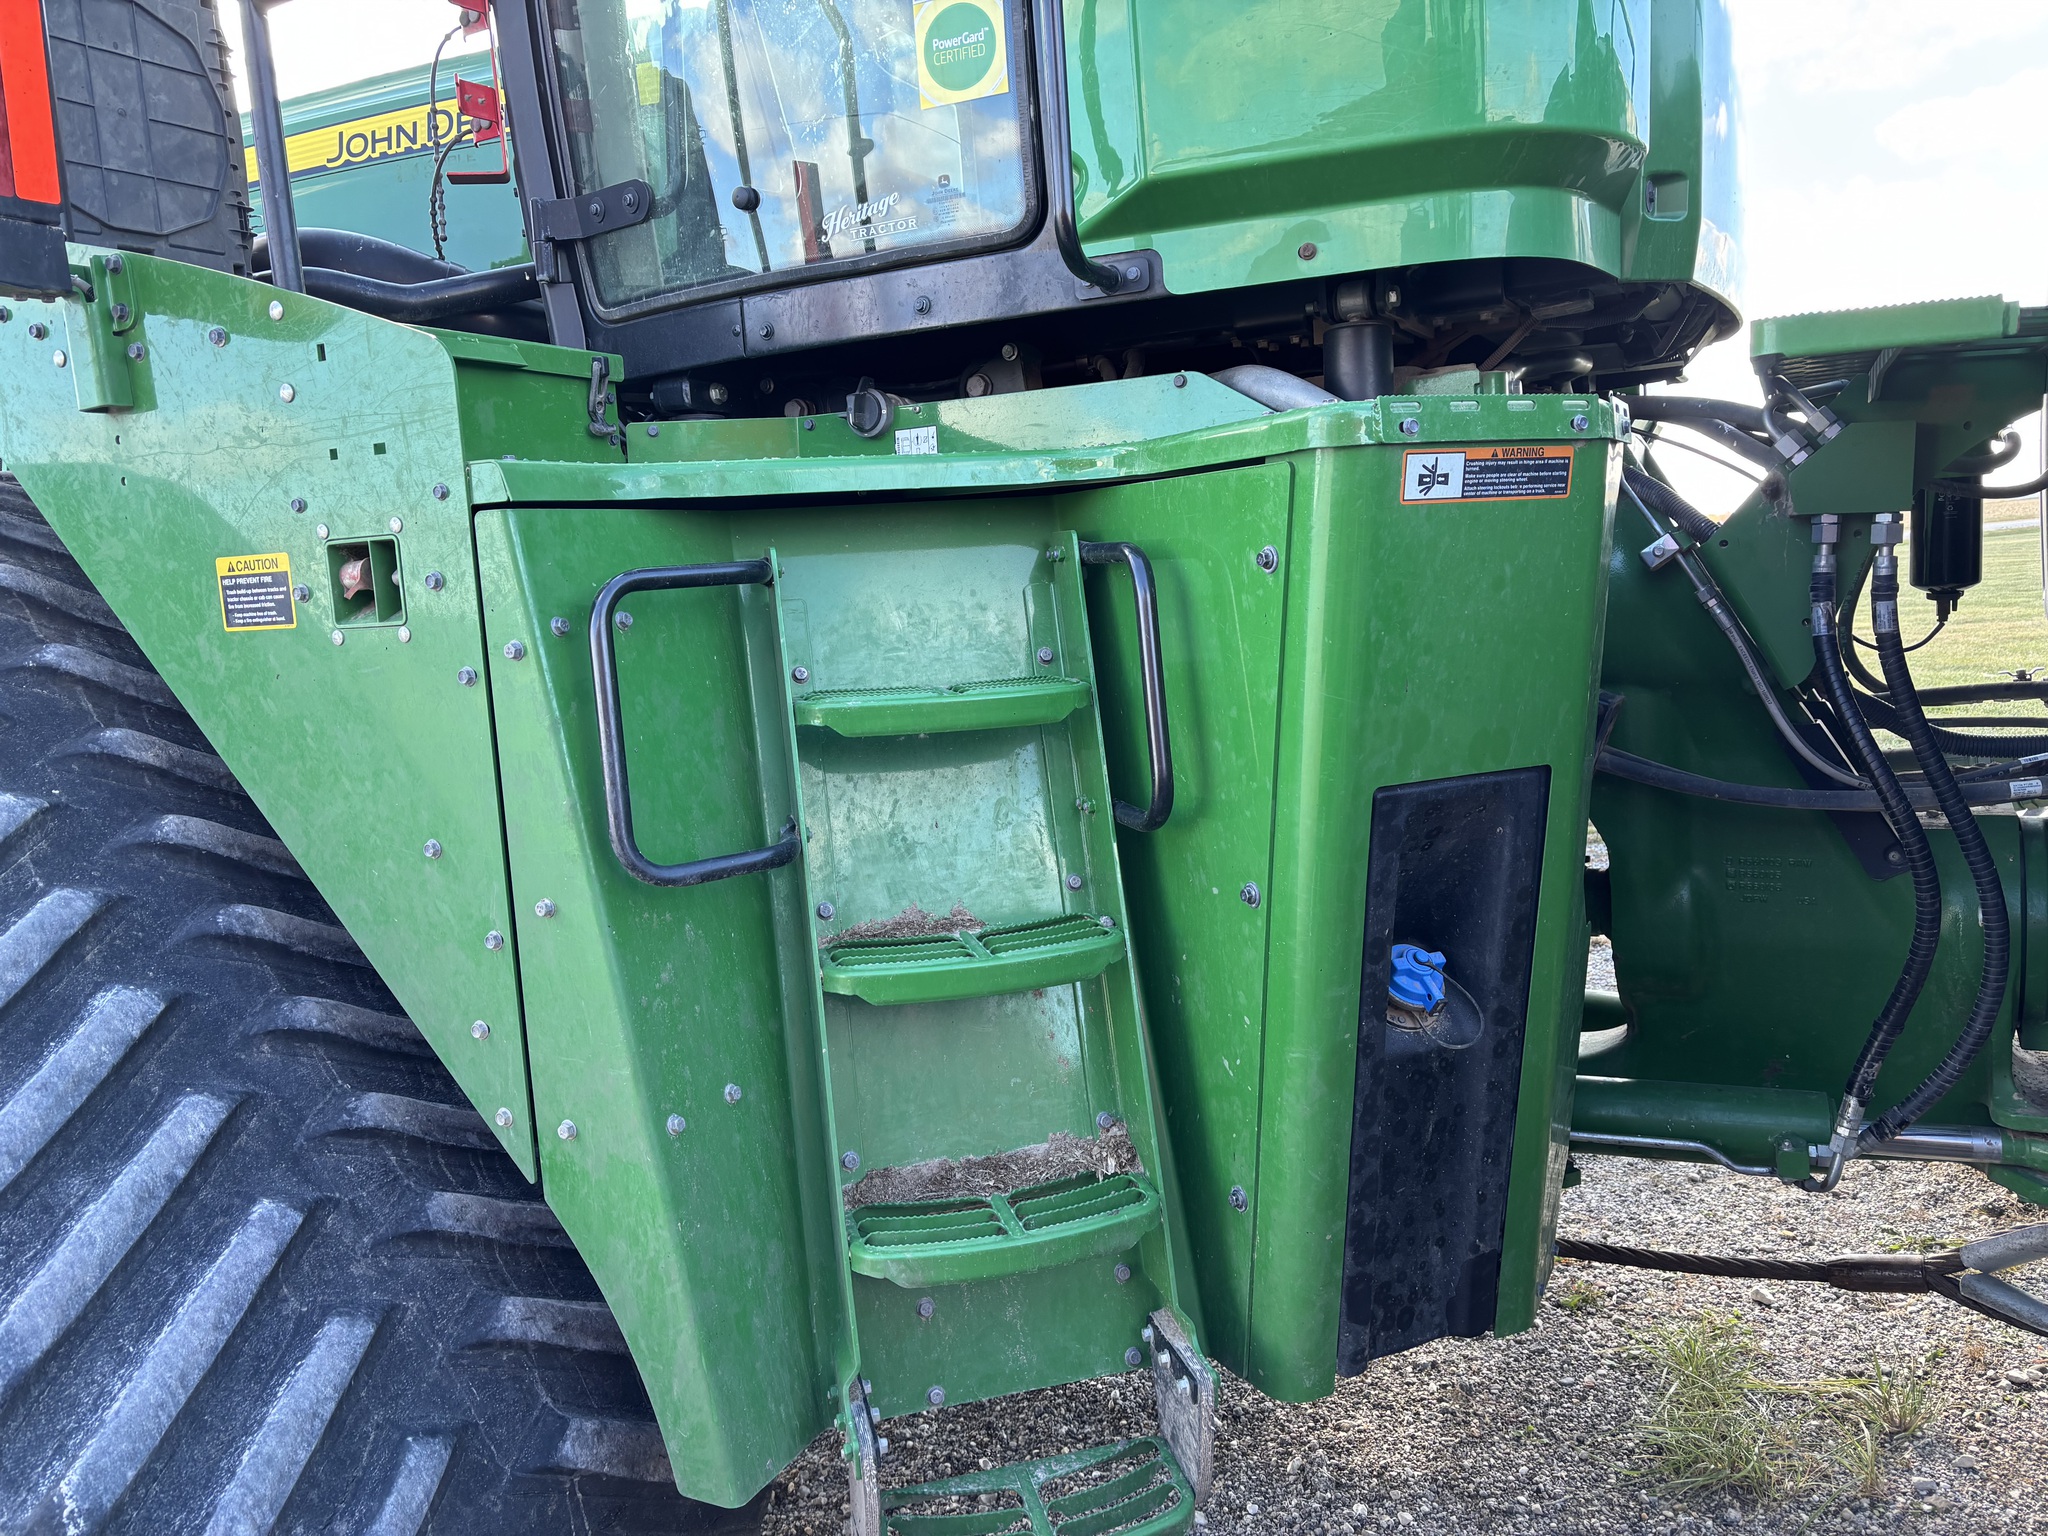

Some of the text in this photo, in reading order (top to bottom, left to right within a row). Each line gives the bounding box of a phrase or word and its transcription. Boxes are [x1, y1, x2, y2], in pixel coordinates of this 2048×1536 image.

[933, 43, 986, 66] CERTIFIED
[326, 121, 418, 164] JOHN
[821, 192, 900, 242] Heritage
[850, 217, 917, 239] TRACTOR
[1502, 447, 1545, 457] WARNING
[236, 558, 279, 572] CAUTION
[222, 578, 236, 586] HELP
[237, 577, 260, 585] PREVENT
